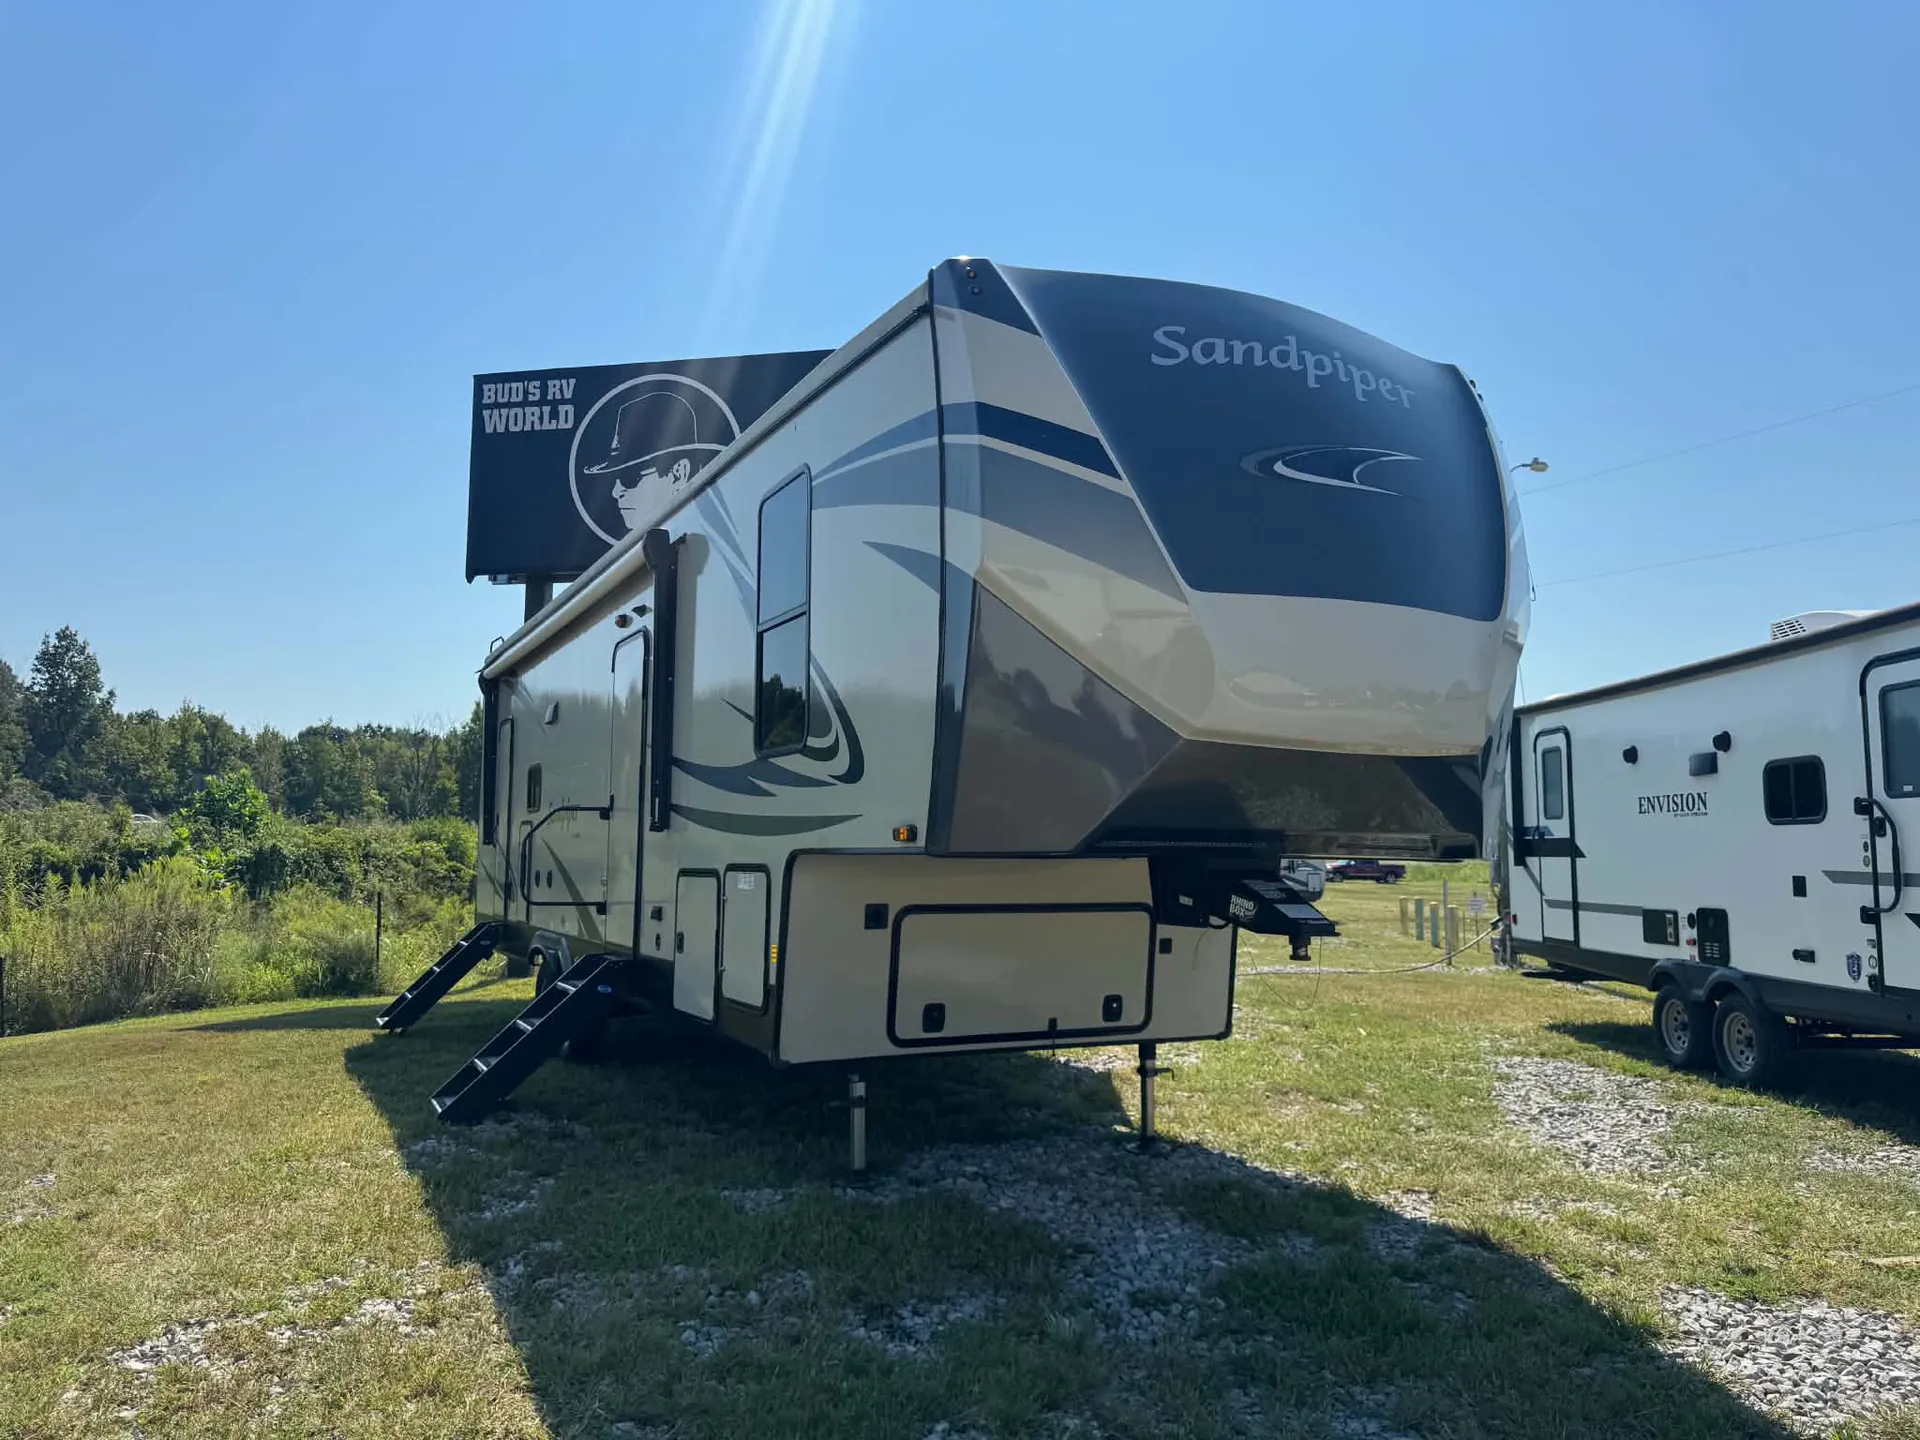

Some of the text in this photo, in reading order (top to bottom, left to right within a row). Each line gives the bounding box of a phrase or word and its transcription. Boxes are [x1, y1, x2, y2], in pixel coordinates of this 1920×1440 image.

[1151, 325, 1416, 409] Sandpiper
[482, 378, 577, 404] BUD'S RV
[482, 404, 575, 433] WORLD
[1638, 792, 1708, 815] ENVISION
[1229, 903, 1246, 918] BOX
[1231, 894, 1254, 911] RHINO
